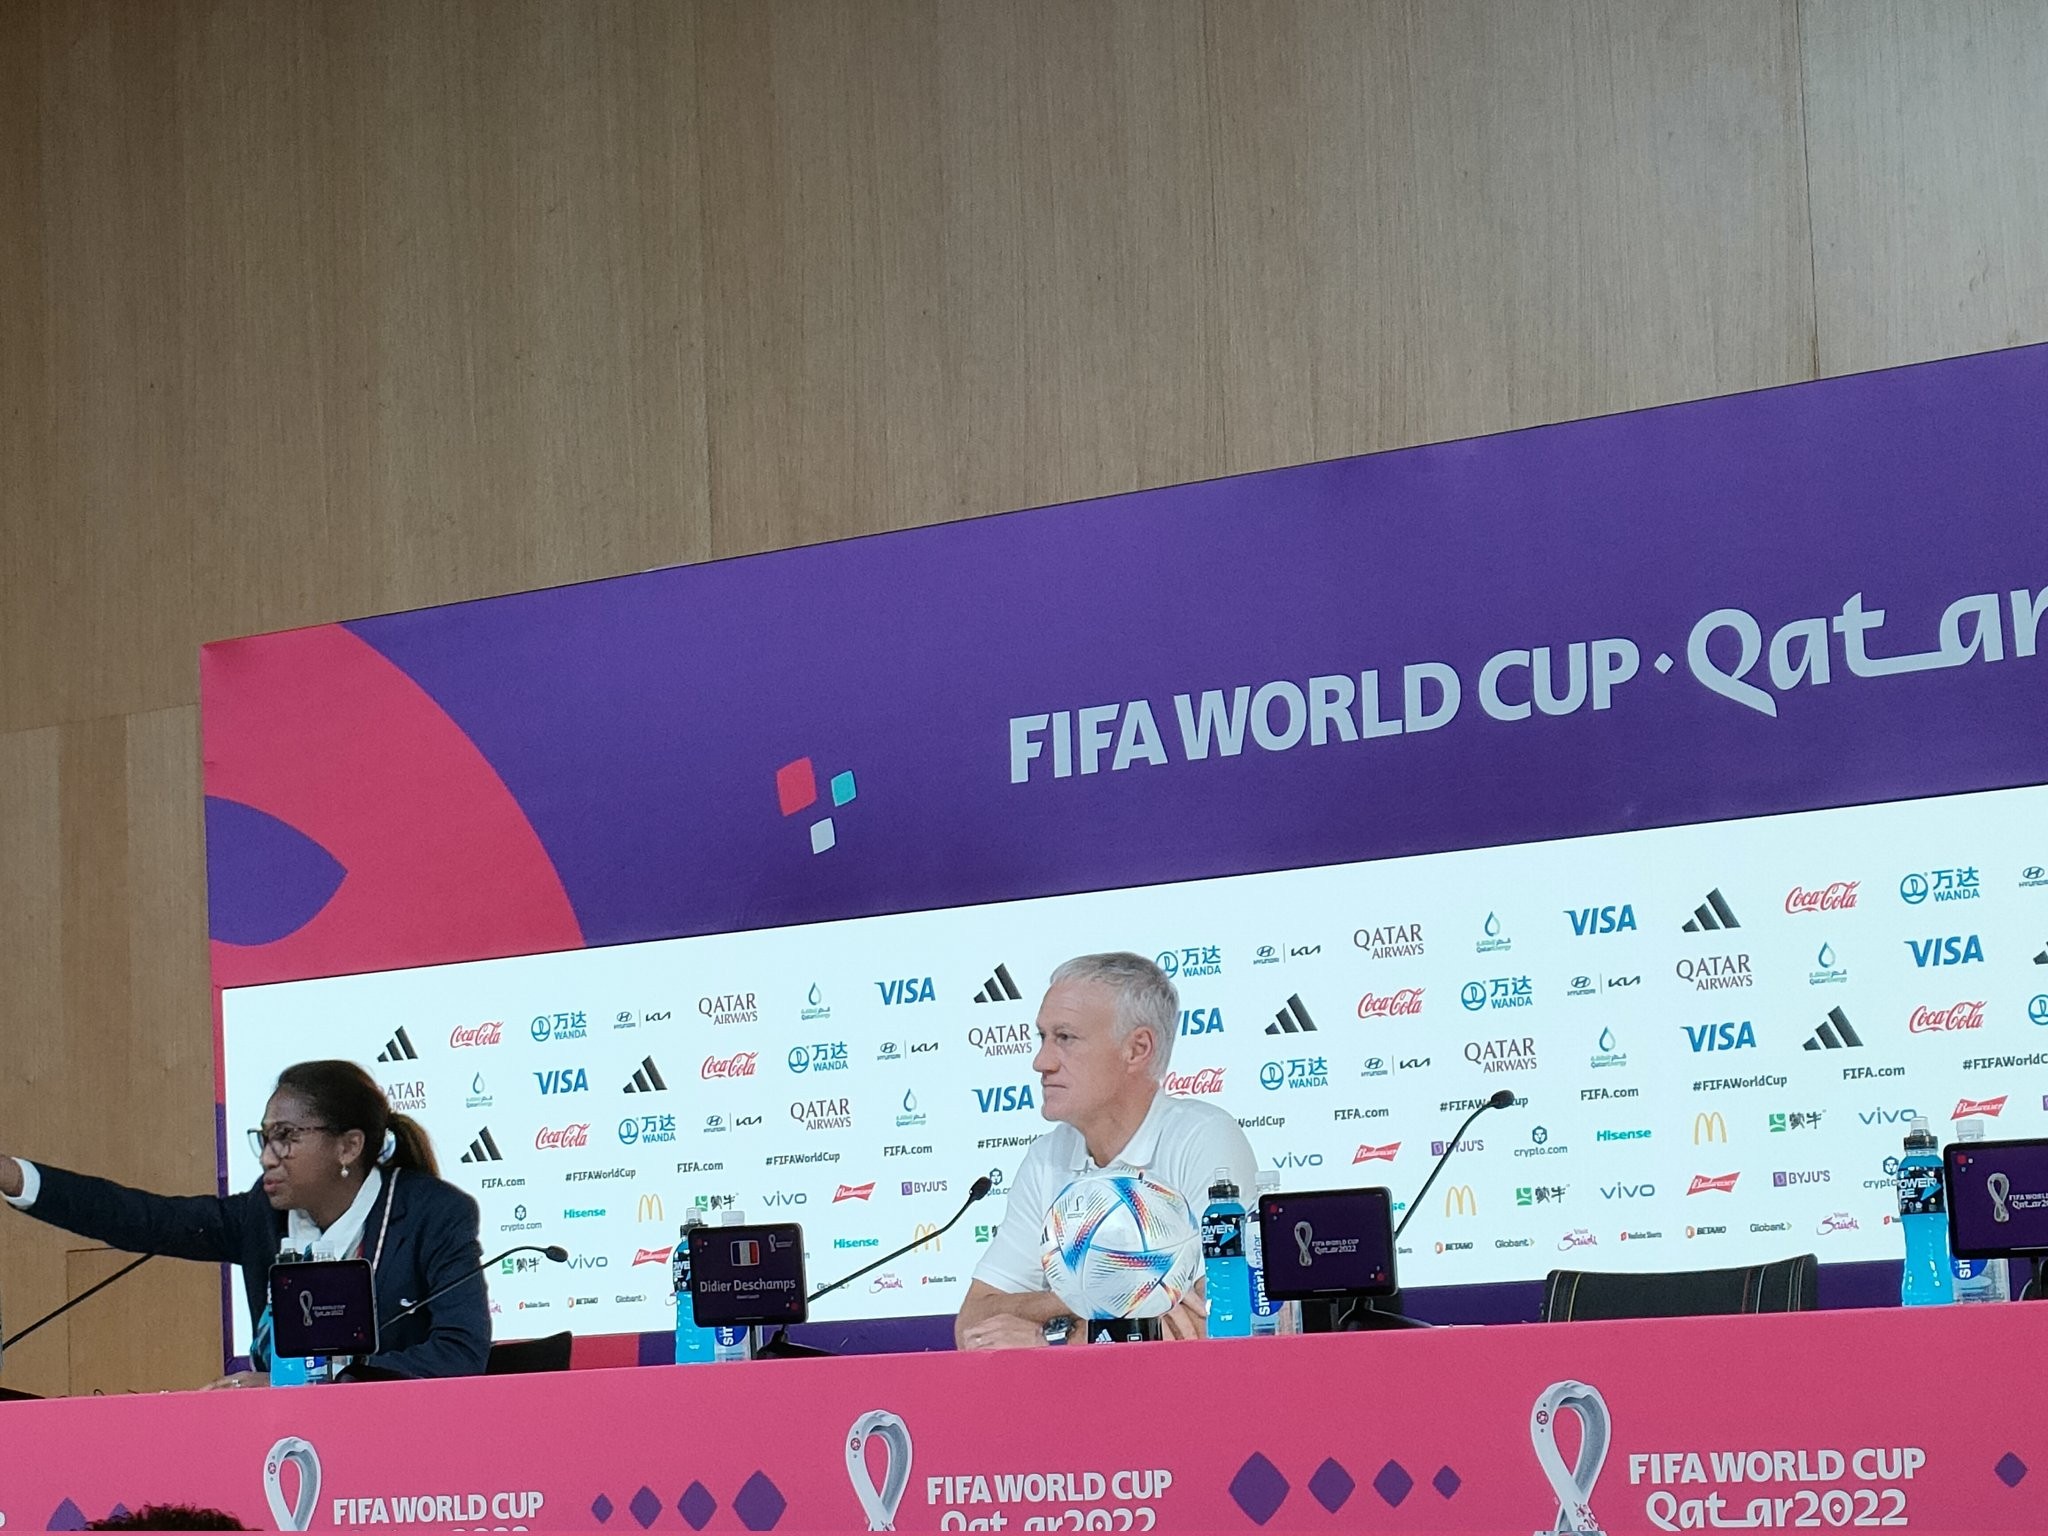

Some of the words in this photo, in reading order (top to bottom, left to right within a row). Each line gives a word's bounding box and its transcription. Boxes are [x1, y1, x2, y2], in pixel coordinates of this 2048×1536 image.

[1010, 699, 1169, 783] FIFA
[1174, 661, 1462, 760] WORLD
[1479, 637, 1641, 721] CUP
[1687, 586, 2048, 717] Qatar
[1932, 867, 1979, 890] 万达
[1786, 882, 1860, 914] Coca-Cola
[1933, 885, 1980, 902] WANDA
[1563, 904, 1637, 936] VISA
[1354, 924, 1424, 953] QATAR
[1182, 945, 1221, 966] 万达
[1372, 941, 1424, 959] AIRWAYS
[1904, 935, 1984, 967] VISA
[1183, 965, 1221, 977] WANDA
[1676, 954, 1752, 984] QATAR
[1490, 976, 1532, 997] 万达
[1696, 972, 1752, 991] AIRWAYS
[874, 977, 935, 1005] VISA
[699, 993, 757, 1020] QATAR
[1358, 988, 1425, 1019] Coca-Cola
[1491, 993, 1532, 1008] WANDA
[553, 1011, 586, 1030] 万达
[714, 1009, 757, 1025] AIRWAYS
[1176, 1007, 1224, 1036] ISA
[1909, 1001, 1987, 1033] Coca-Cola
[450, 1022, 503, 1048] Coca-Cola
[554, 1029, 587, 1040] WANDA
[969, 1024, 1032, 1049] QATAR
[1681, 1021, 1756, 1052] VISA
[812, 1041, 847, 1061] 万达
[985, 1040, 1032, 1057] AIRWAYS
[1465, 1038, 1537, 1066] QATAR
[702, 1052, 758, 1079] Coca-Cola
[813, 1057, 848, 1071] WANDA
[1287, 1057, 1327, 1077] 万达
[1483, 1054, 1537, 1073] AIRWAYS
[1962, 1053, 2048, 1070] #FIFAWorldC
[533, 1068, 588, 1095] VISA
[1288, 1072, 1328, 1088] WANDA
[1843, 1067, 1905, 1080] FIFA.com
[381, 1081, 425, 1100] ATAR
[1693, 1075, 1787, 1091] #FIFAWorldCup
[972, 1085, 1034, 1113] VISA
[1581, 1088, 1638, 1100] FIFA.com
[391, 1098, 426, 1112] IRWAYS
[791, 1099, 851, 1125] QATAR
[642, 1114, 675, 1132] 万达
[806, 1117, 851, 1130] AIRWAYS
[1335, 1109, 1389, 1120] FIFA.com
[1858, 1106, 1918, 1125] vivo
[536, 1124, 590, 1150] Coca-Cola
[643, 1132, 676, 1143] WANDA
[1597, 1130, 1651, 1141] Hisense
[766, 1152, 840, 1165] #FIFAWorldCup
[884, 1145, 932, 1156] FIFA.com
[1514, 1146, 1567, 1157] crypto.com
[677, 1162, 723, 1173] FIFA.com
[1272, 1152, 1323, 1168] vivo
[482, 1178, 525, 1188] FIFA.com
[566, 1168, 636, 1181] #FIFAWorldCup
[1789, 1170, 1830, 1184] BYJU'S
[914, 1180, 947, 1193] BYJU'S
[1600, 1182, 1655, 1199] vivo
[1863, 1178, 1897, 1190] crypto
[763, 1191, 807, 1206] vivo
[564, 1209, 606, 1218] Hisense
[501, 1223, 542, 1231] crypto.com
[834, 1239, 878, 1248] Hisense
[566, 1252, 609, 1270] vivo
[700, 1281, 731, 1292] Didier
[734, 1278, 795, 1292] Deschamps
[1629, 1453, 1707, 1484] FIFA
[1710, 1449, 1845, 1482] WORLD
[1853, 1447, 1926, 1480] CUP
[927, 1476, 993, 1504] FIFA
[994, 1473, 1107, 1502] WORLD
[1112, 1470, 1173, 1499] CUP
[334, 1498, 390, 1524] FIFA
[391, 1495, 488, 1523] WORLD
[492, 1492, 544, 1519] CUP
[1646, 1488, 1909, 1531] Qatar2022
